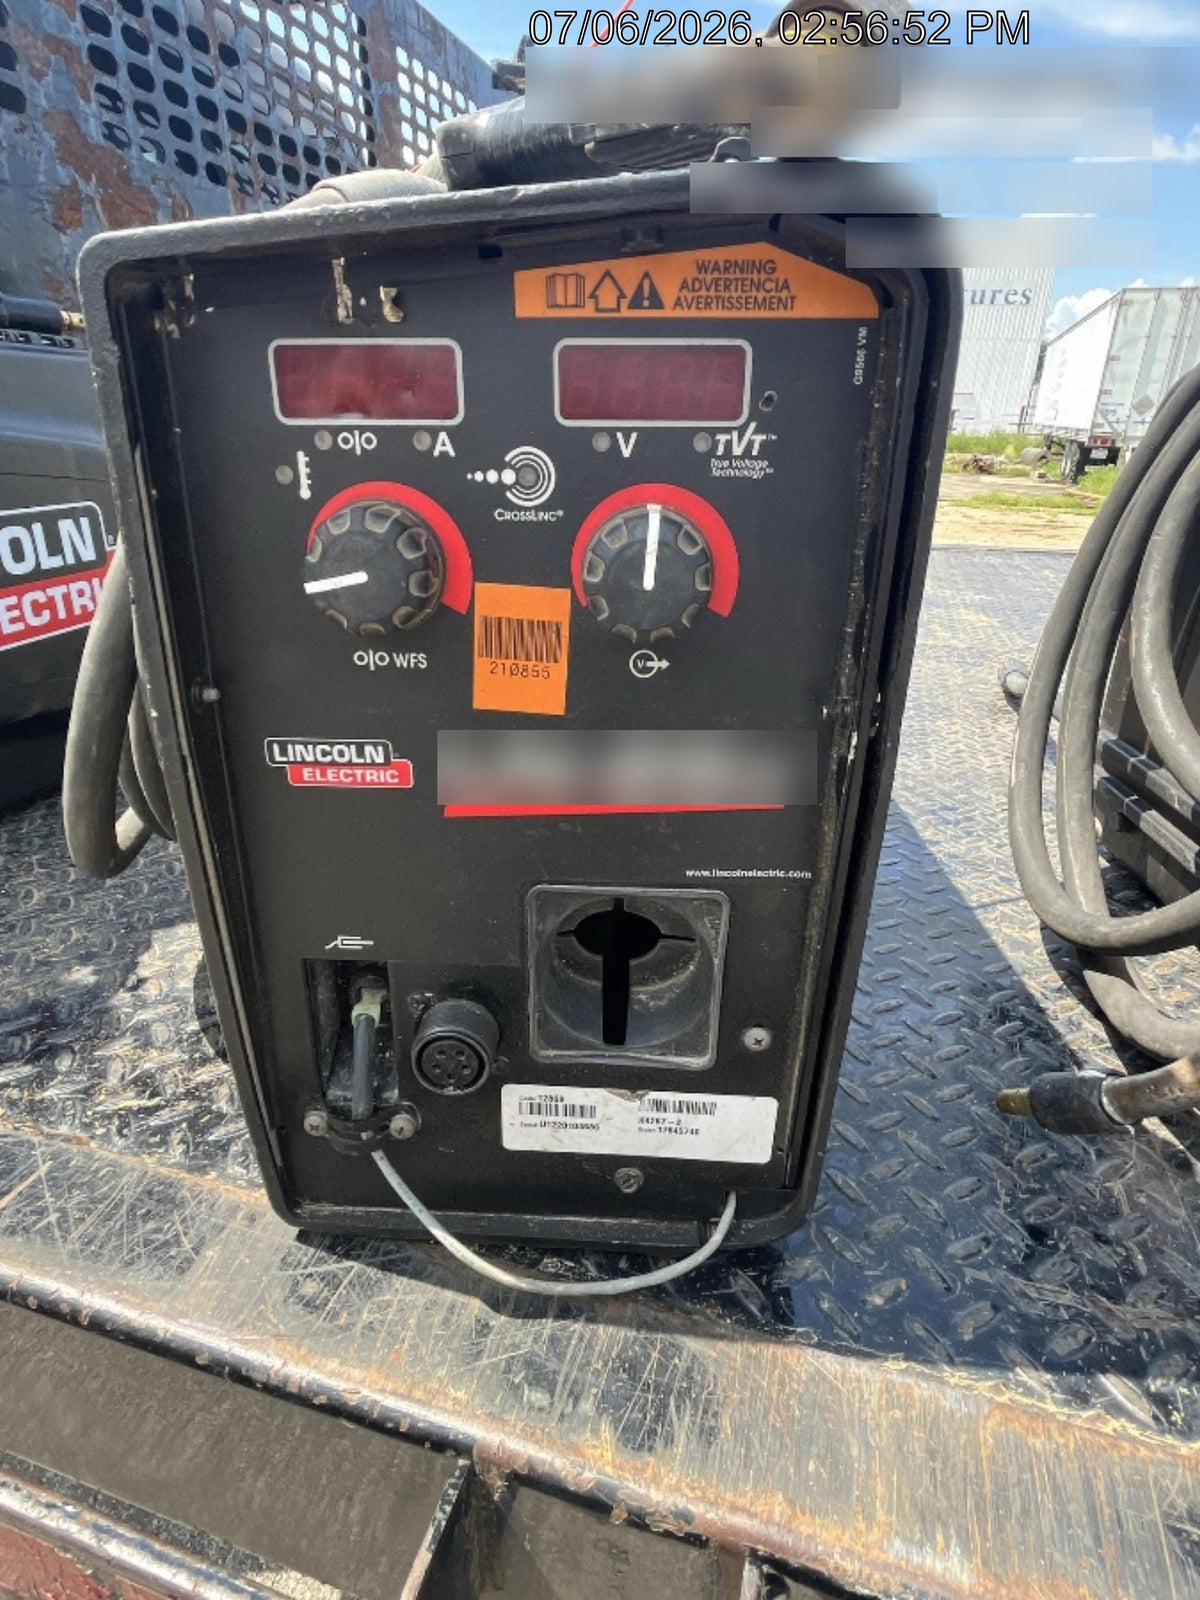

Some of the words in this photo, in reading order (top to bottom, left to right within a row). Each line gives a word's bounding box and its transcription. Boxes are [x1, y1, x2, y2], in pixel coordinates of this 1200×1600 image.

[696, 258, 778, 276] WARNING
[679, 276, 792, 294] ADVERTENCIA
[673, 294, 797, 311] AVERTISSEMENT
[964, 287, 1032, 305] ures
[433, 432, 456, 457] A
[616, 432, 638, 457] V
[731, 457, 769, 471] Voltage
[392, 651, 428, 670] WFS
[489, 660, 551, 680] 210855
[272, 741, 387, 764] LINCOLN
[302, 766, 400, 785] ELECTRIC
[685, 867, 813, 879] www.lincolnelectric.com
